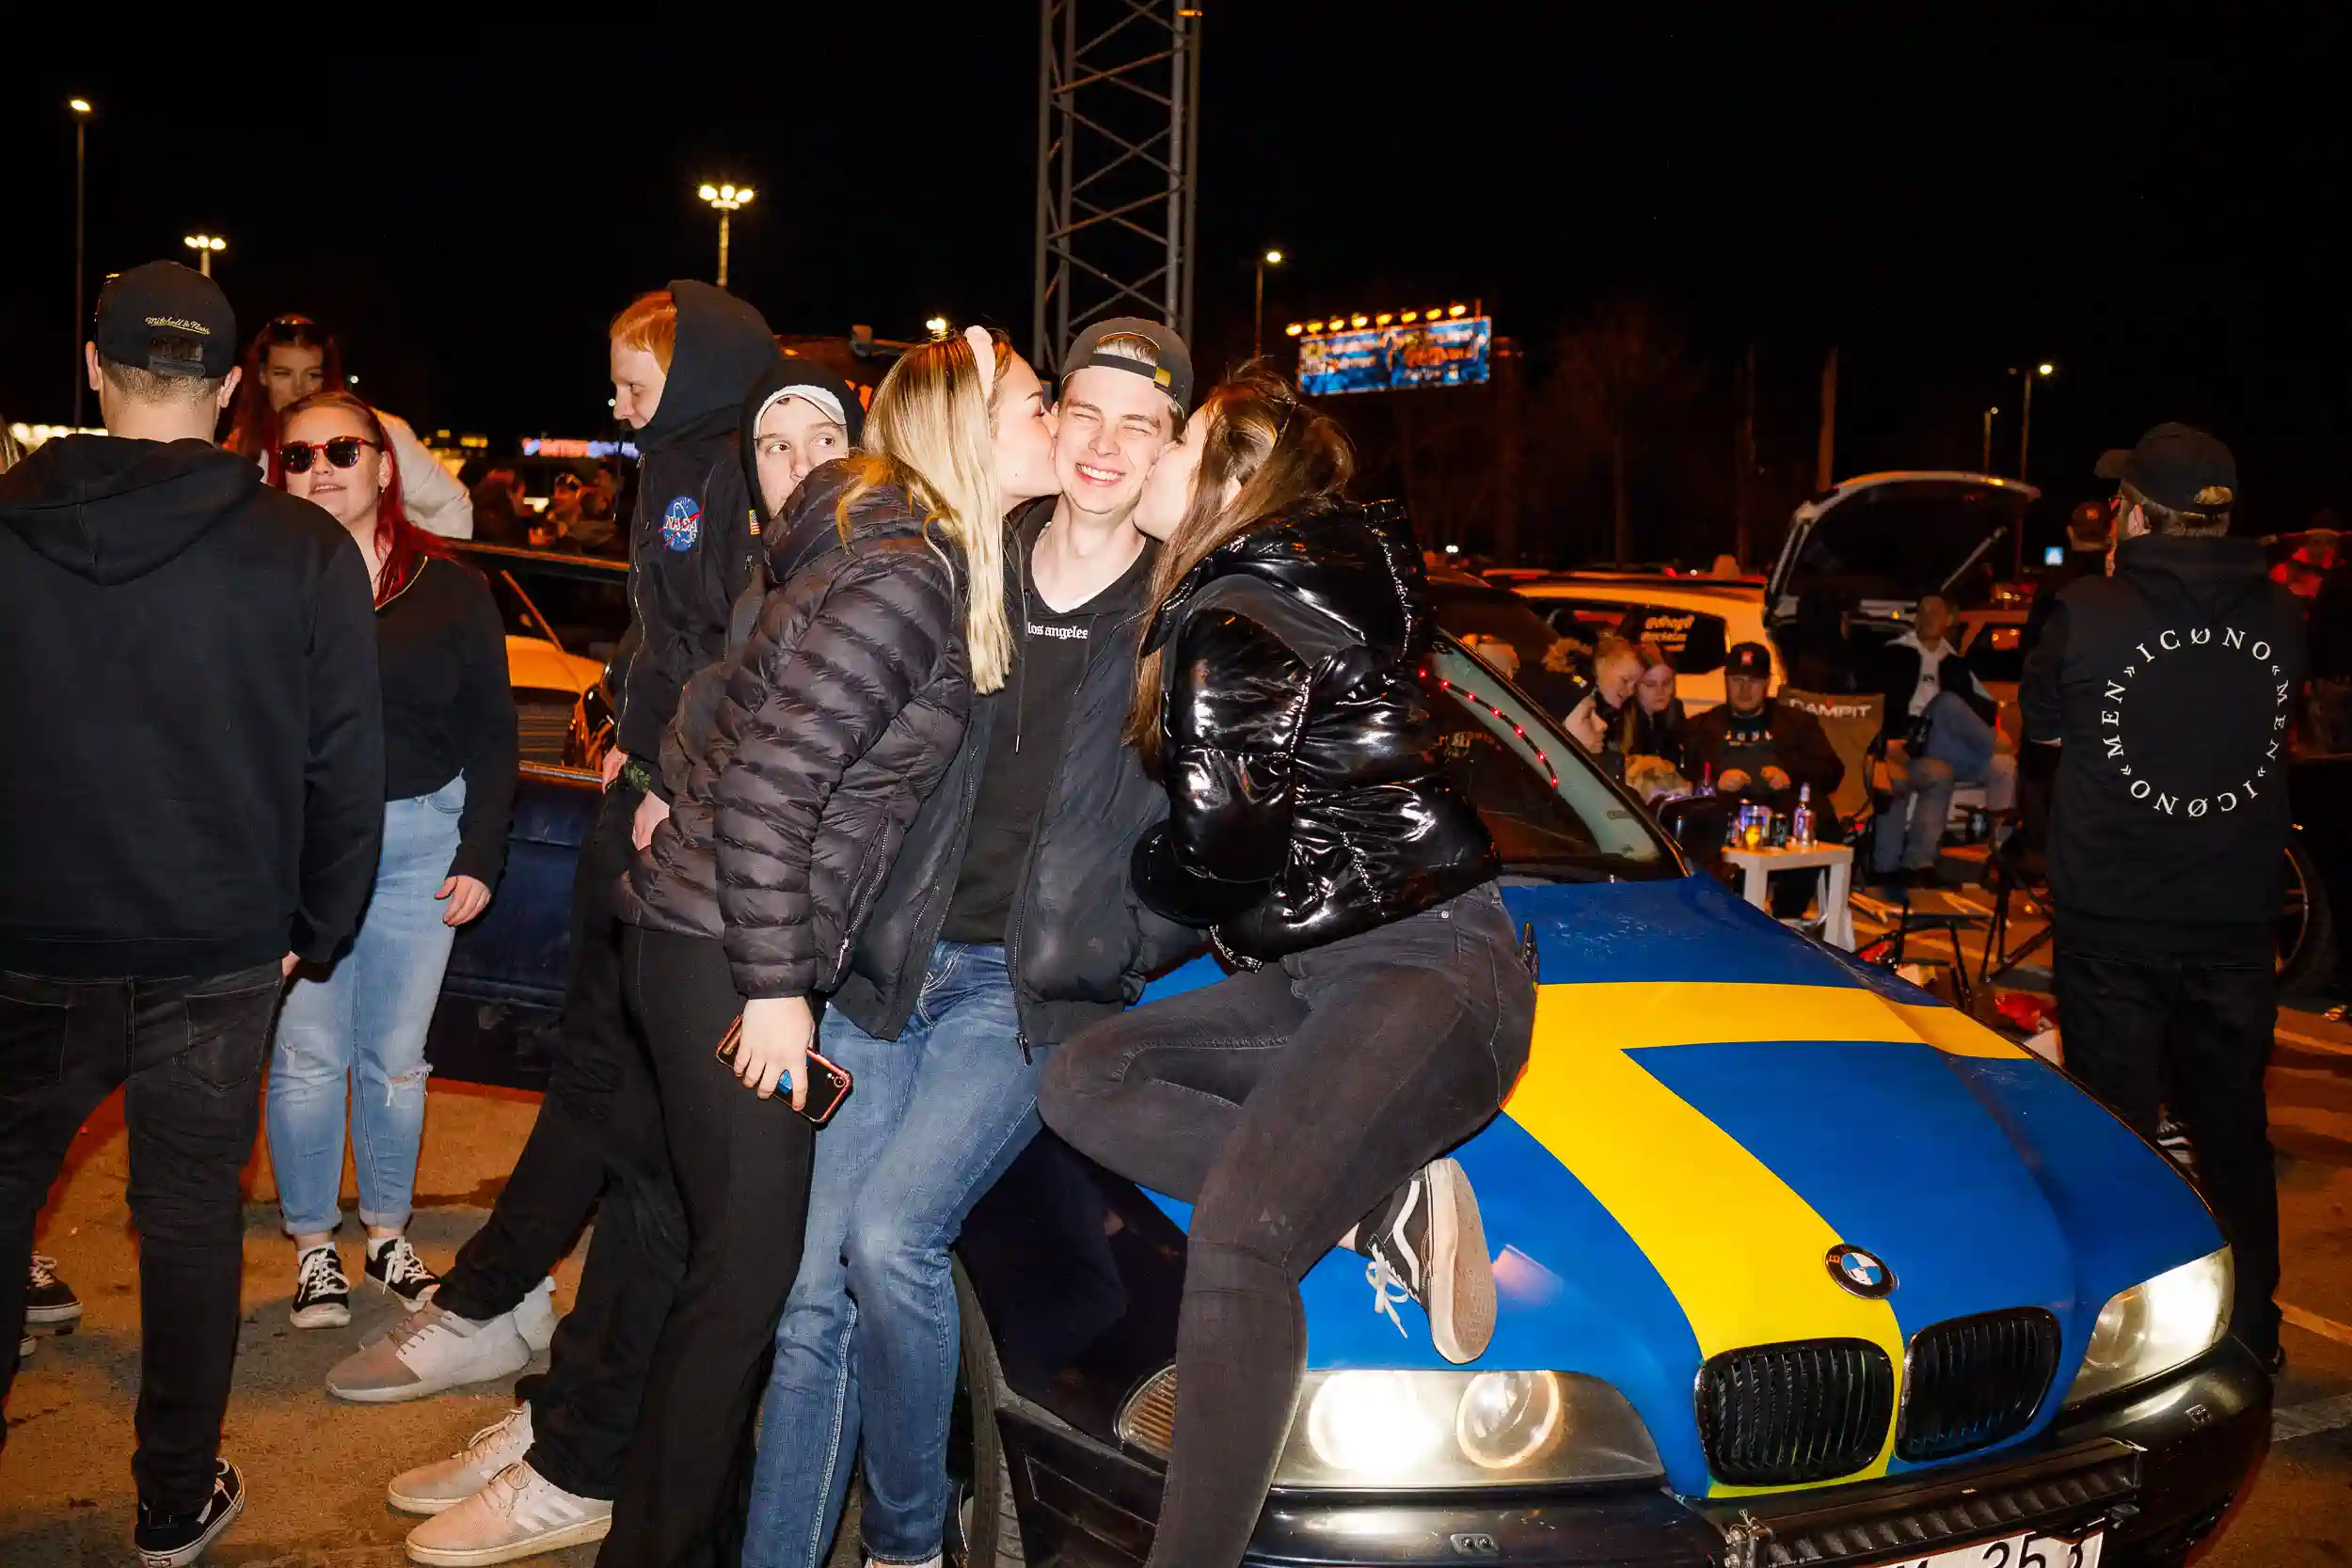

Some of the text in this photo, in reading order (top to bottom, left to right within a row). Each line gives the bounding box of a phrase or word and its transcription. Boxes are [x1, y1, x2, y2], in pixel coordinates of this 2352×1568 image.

[145, 316, 184, 326] Mitchell
[1027, 621, 1089, 640] los angeles
